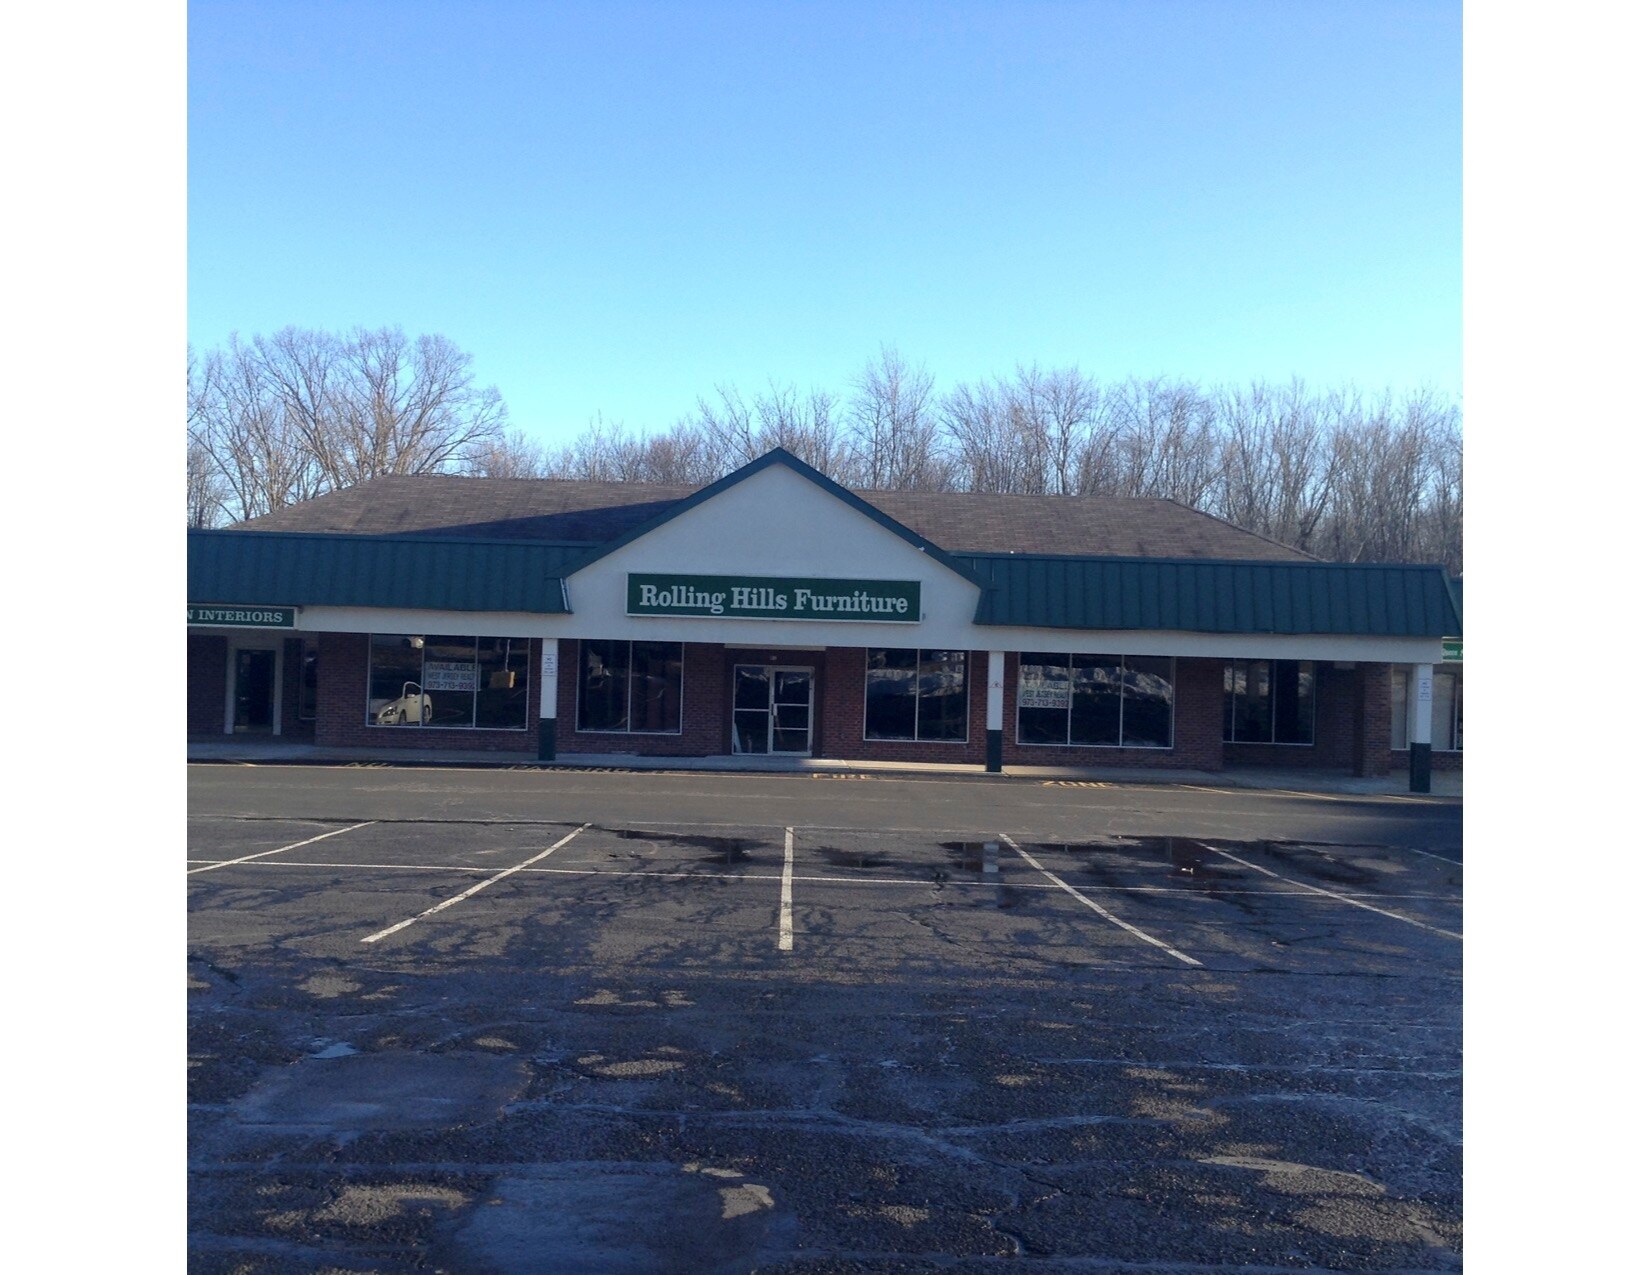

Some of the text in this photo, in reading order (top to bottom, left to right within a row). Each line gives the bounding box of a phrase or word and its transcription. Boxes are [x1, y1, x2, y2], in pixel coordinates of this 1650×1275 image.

[639, 584, 908, 614] Rolling Hills Furniture
[198, 609, 283, 623] INTERIORS
